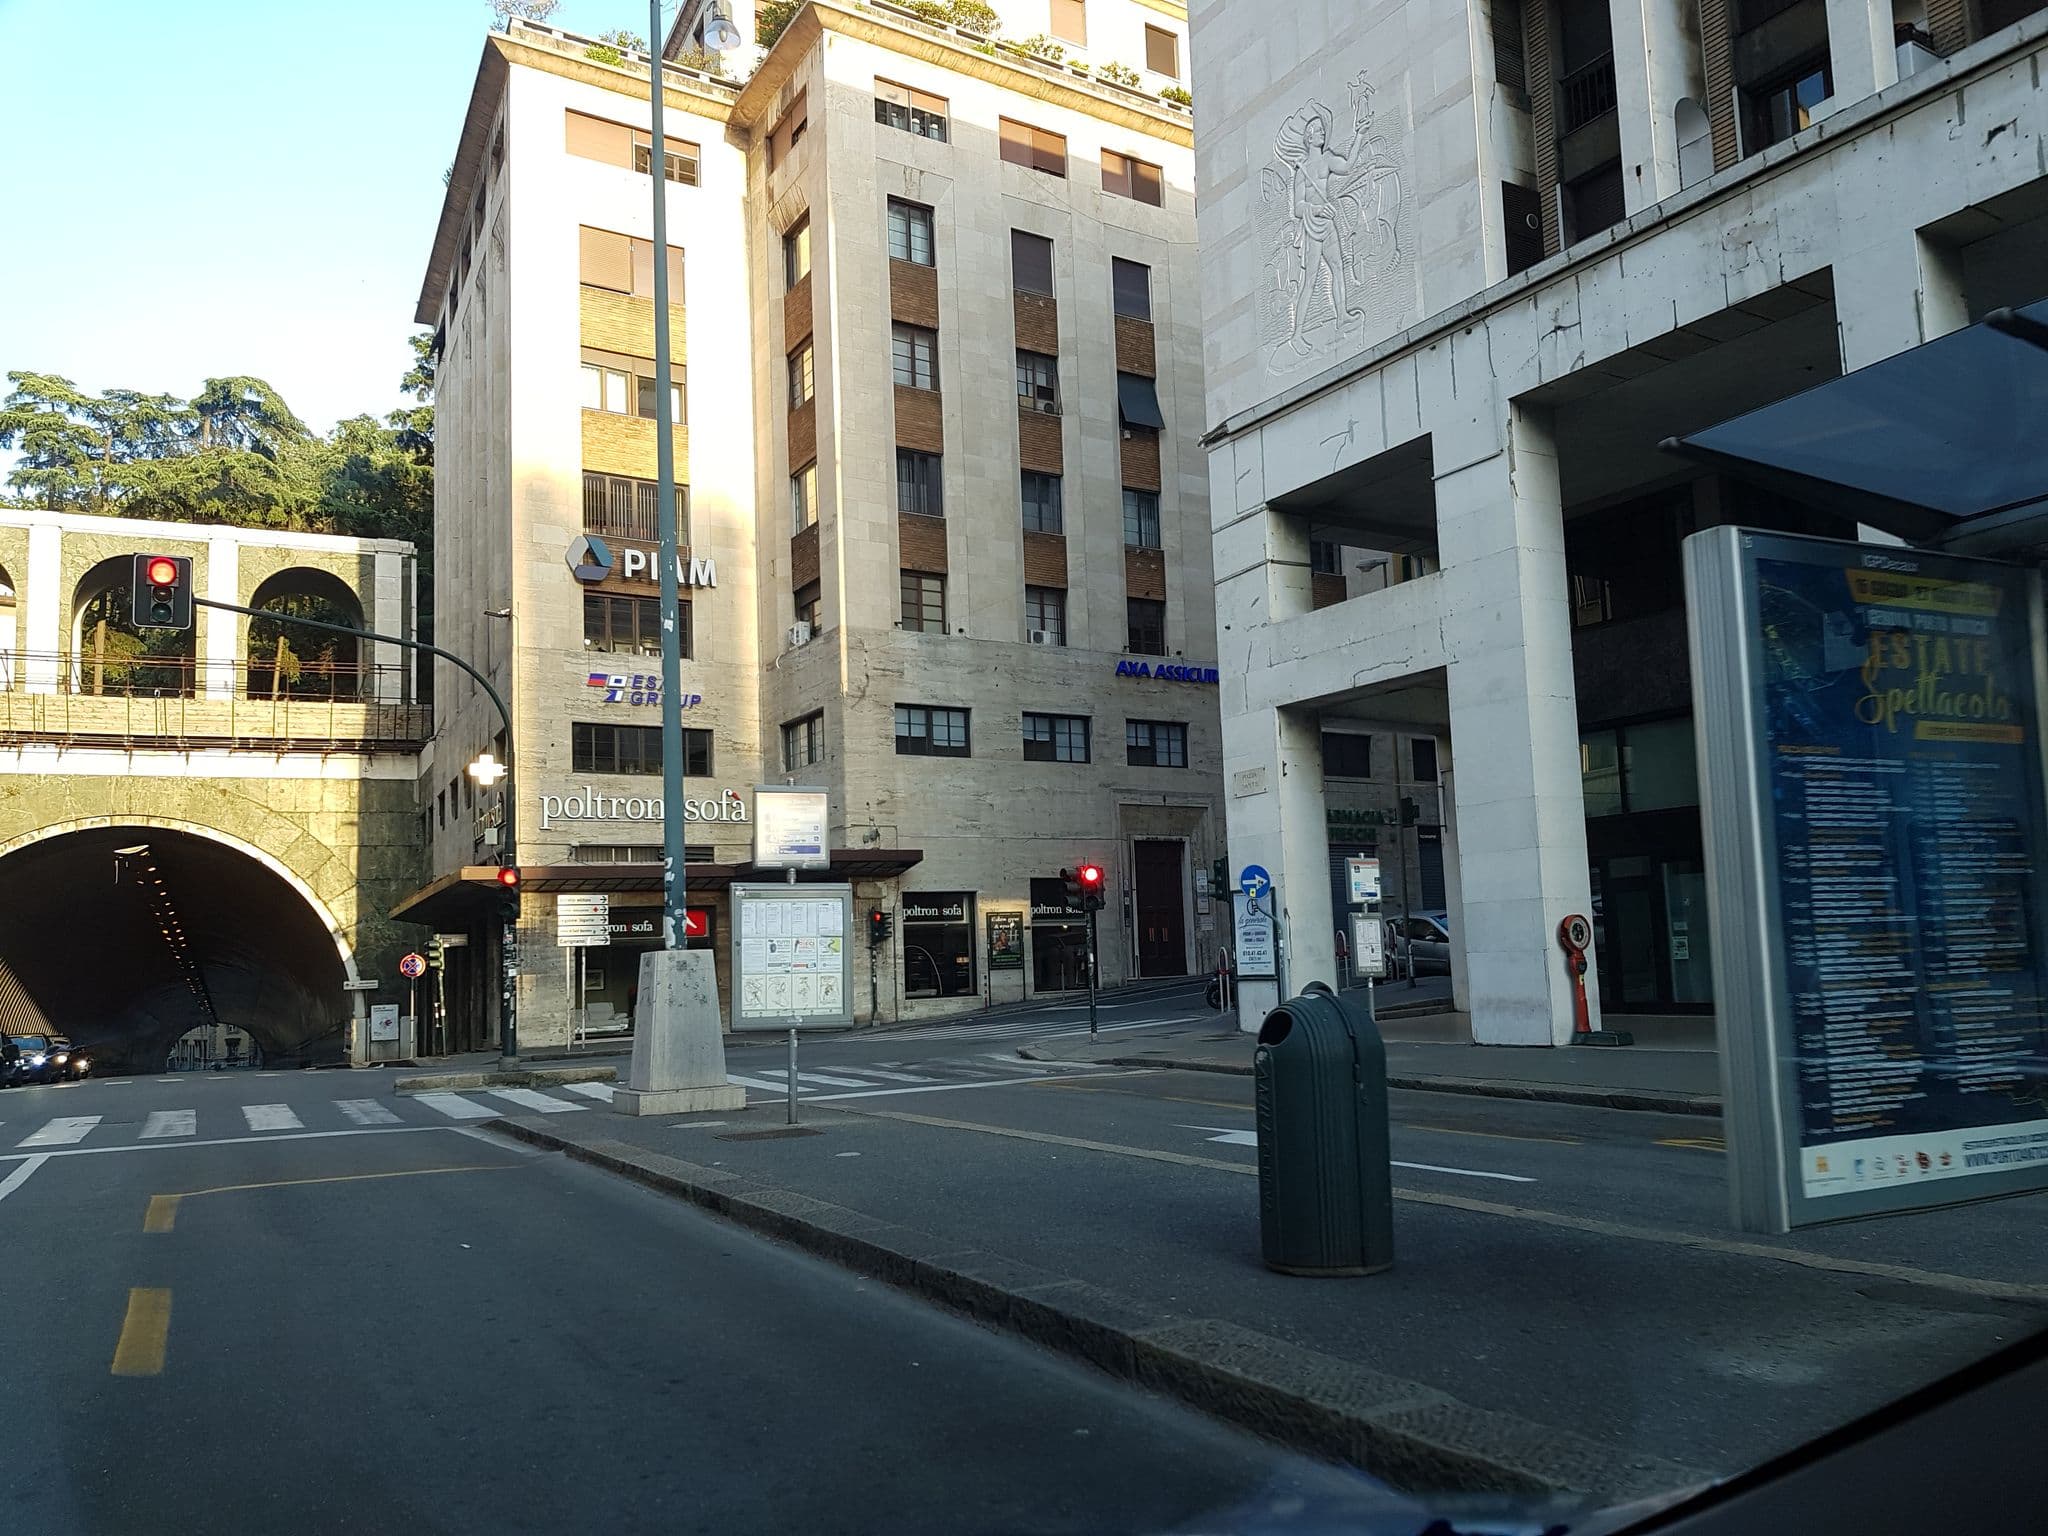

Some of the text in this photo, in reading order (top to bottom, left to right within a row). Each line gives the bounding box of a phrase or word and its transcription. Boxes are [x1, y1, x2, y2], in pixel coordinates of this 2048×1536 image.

[1869, 630, 1992, 676] ESTATE
[631, 675, 665, 690] ES
[1116, 661, 1151, 678] AXA
[630, 691, 702, 708] GRUP
[1855, 652, 2011, 734] Spettacolo
[539, 785, 749, 830] poltronsofà
